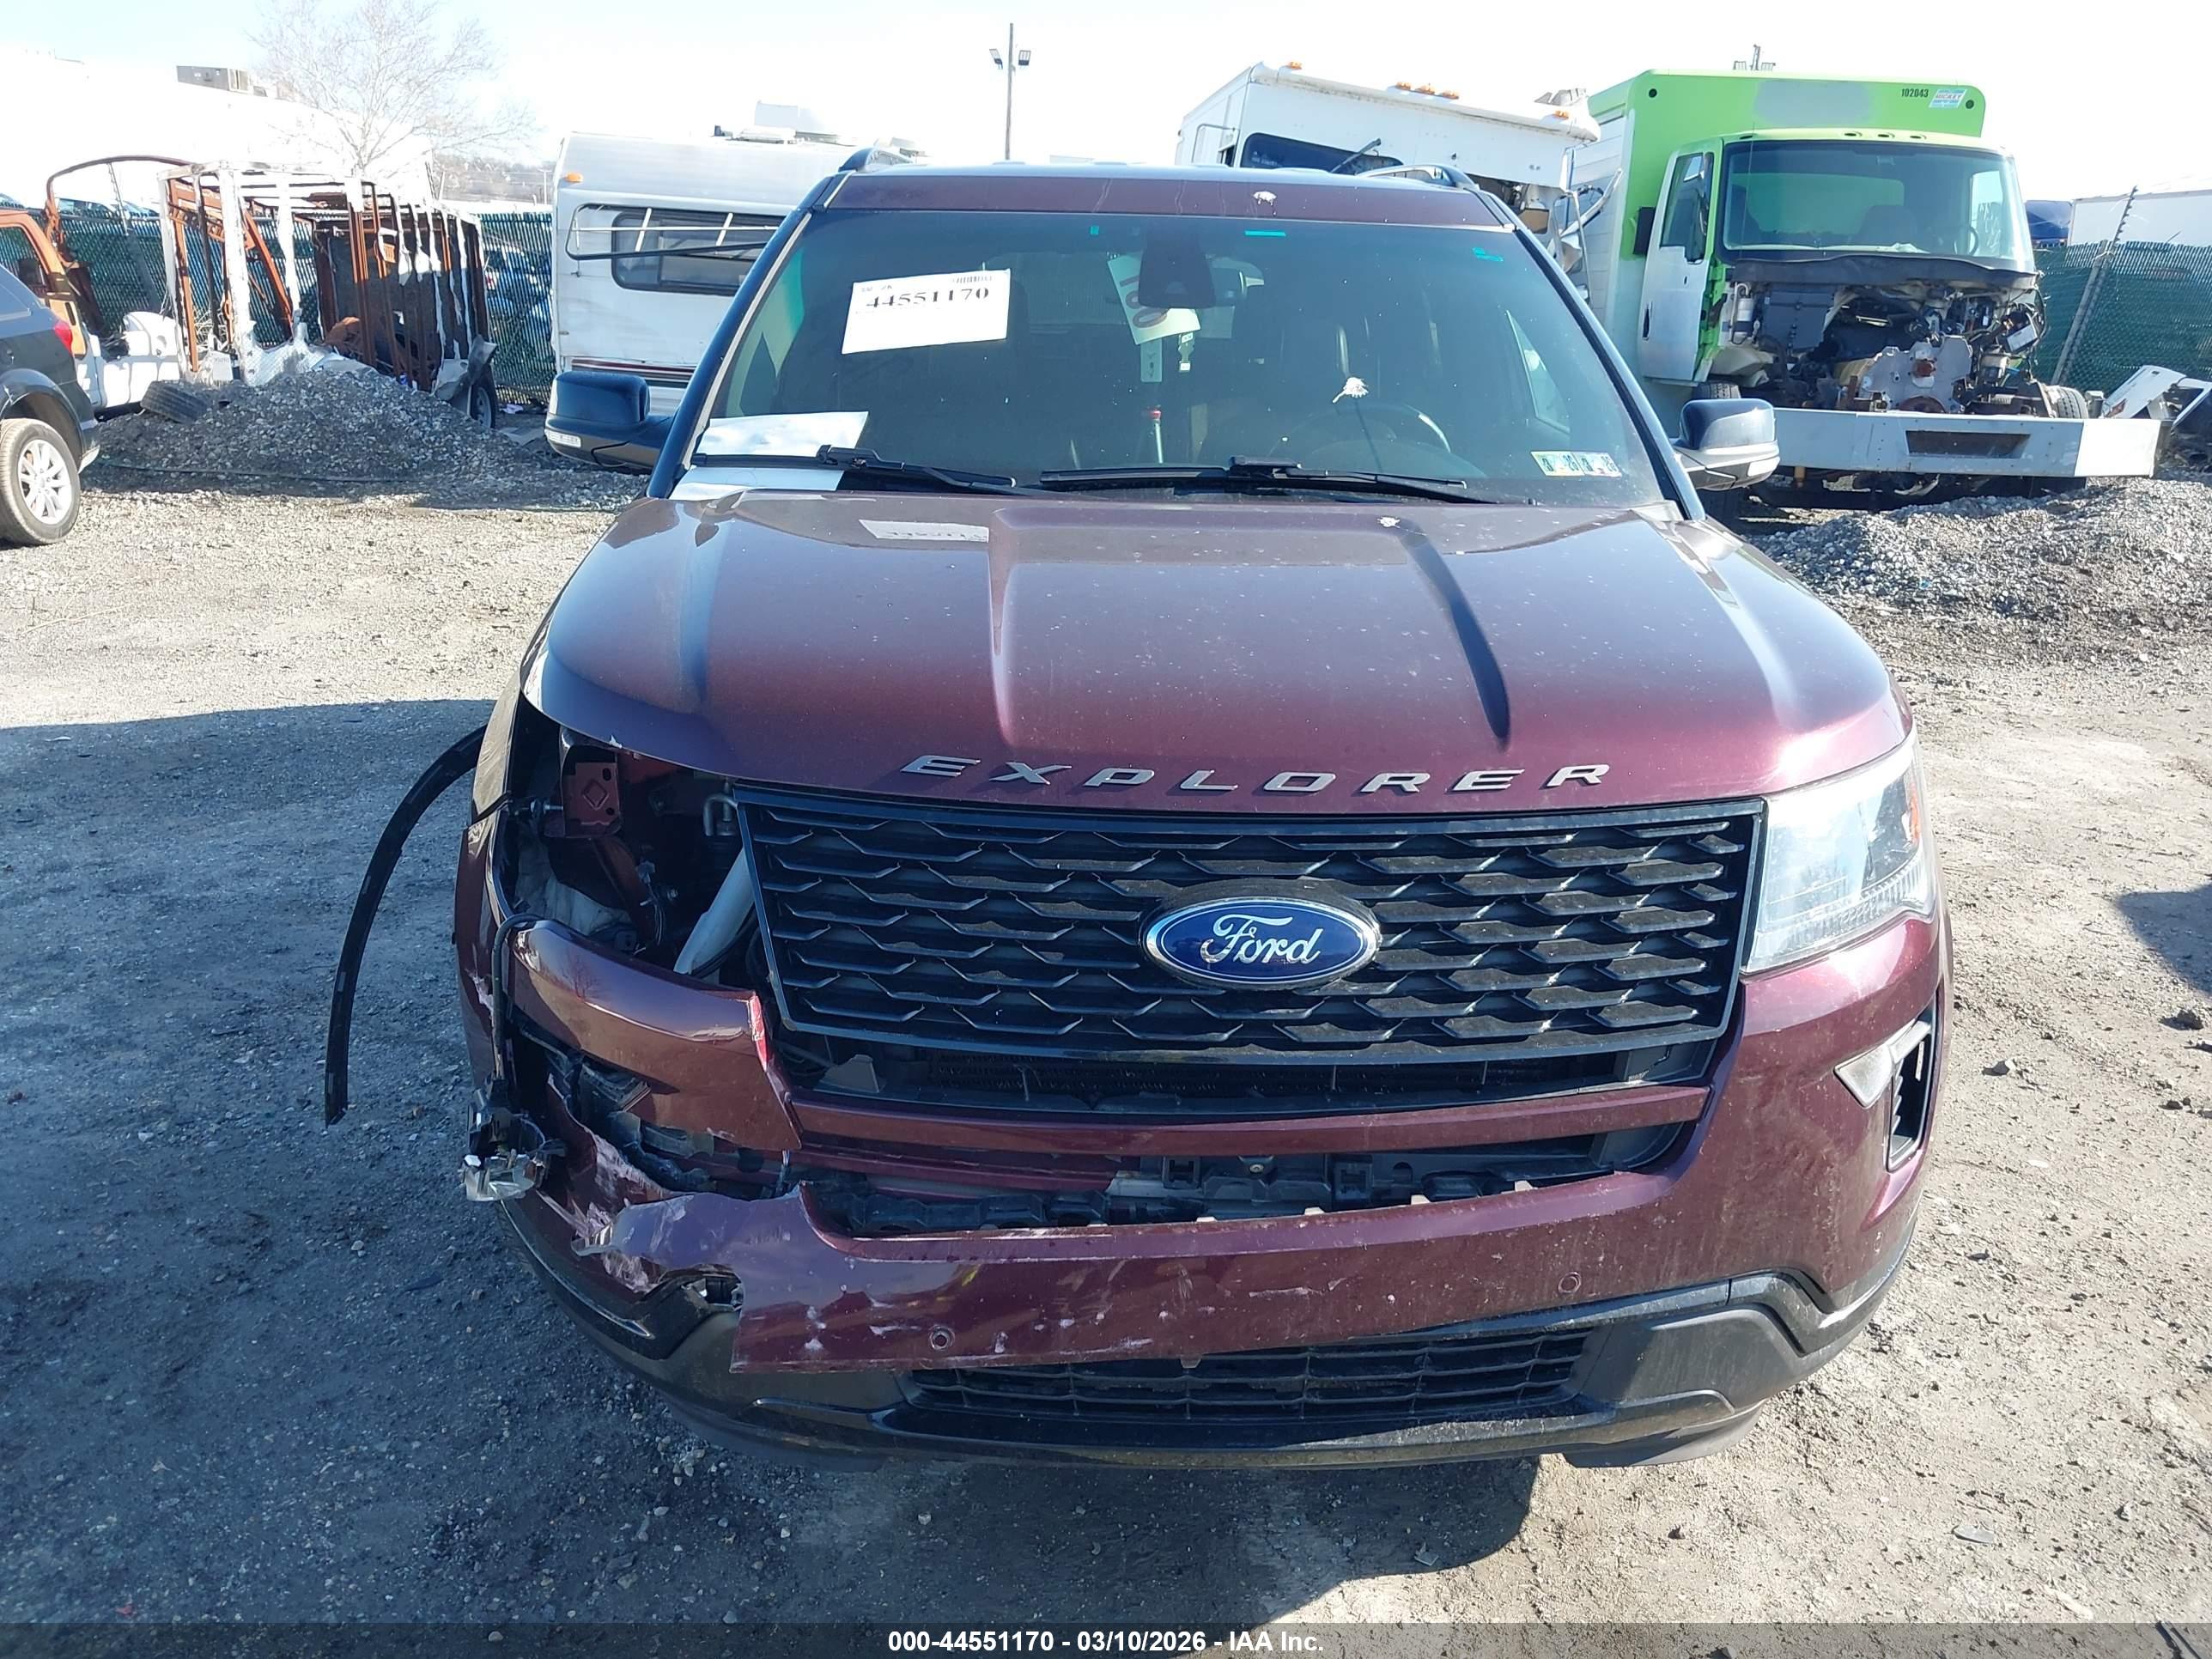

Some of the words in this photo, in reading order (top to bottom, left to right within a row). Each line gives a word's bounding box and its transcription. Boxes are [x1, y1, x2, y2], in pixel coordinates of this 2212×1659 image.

[1901, 88, 1929, 98] 102043
[866, 287, 989, 308] 44551170
[901, 755, 1611, 793] EXPLORER
[1200, 913, 1322, 966] Ford
